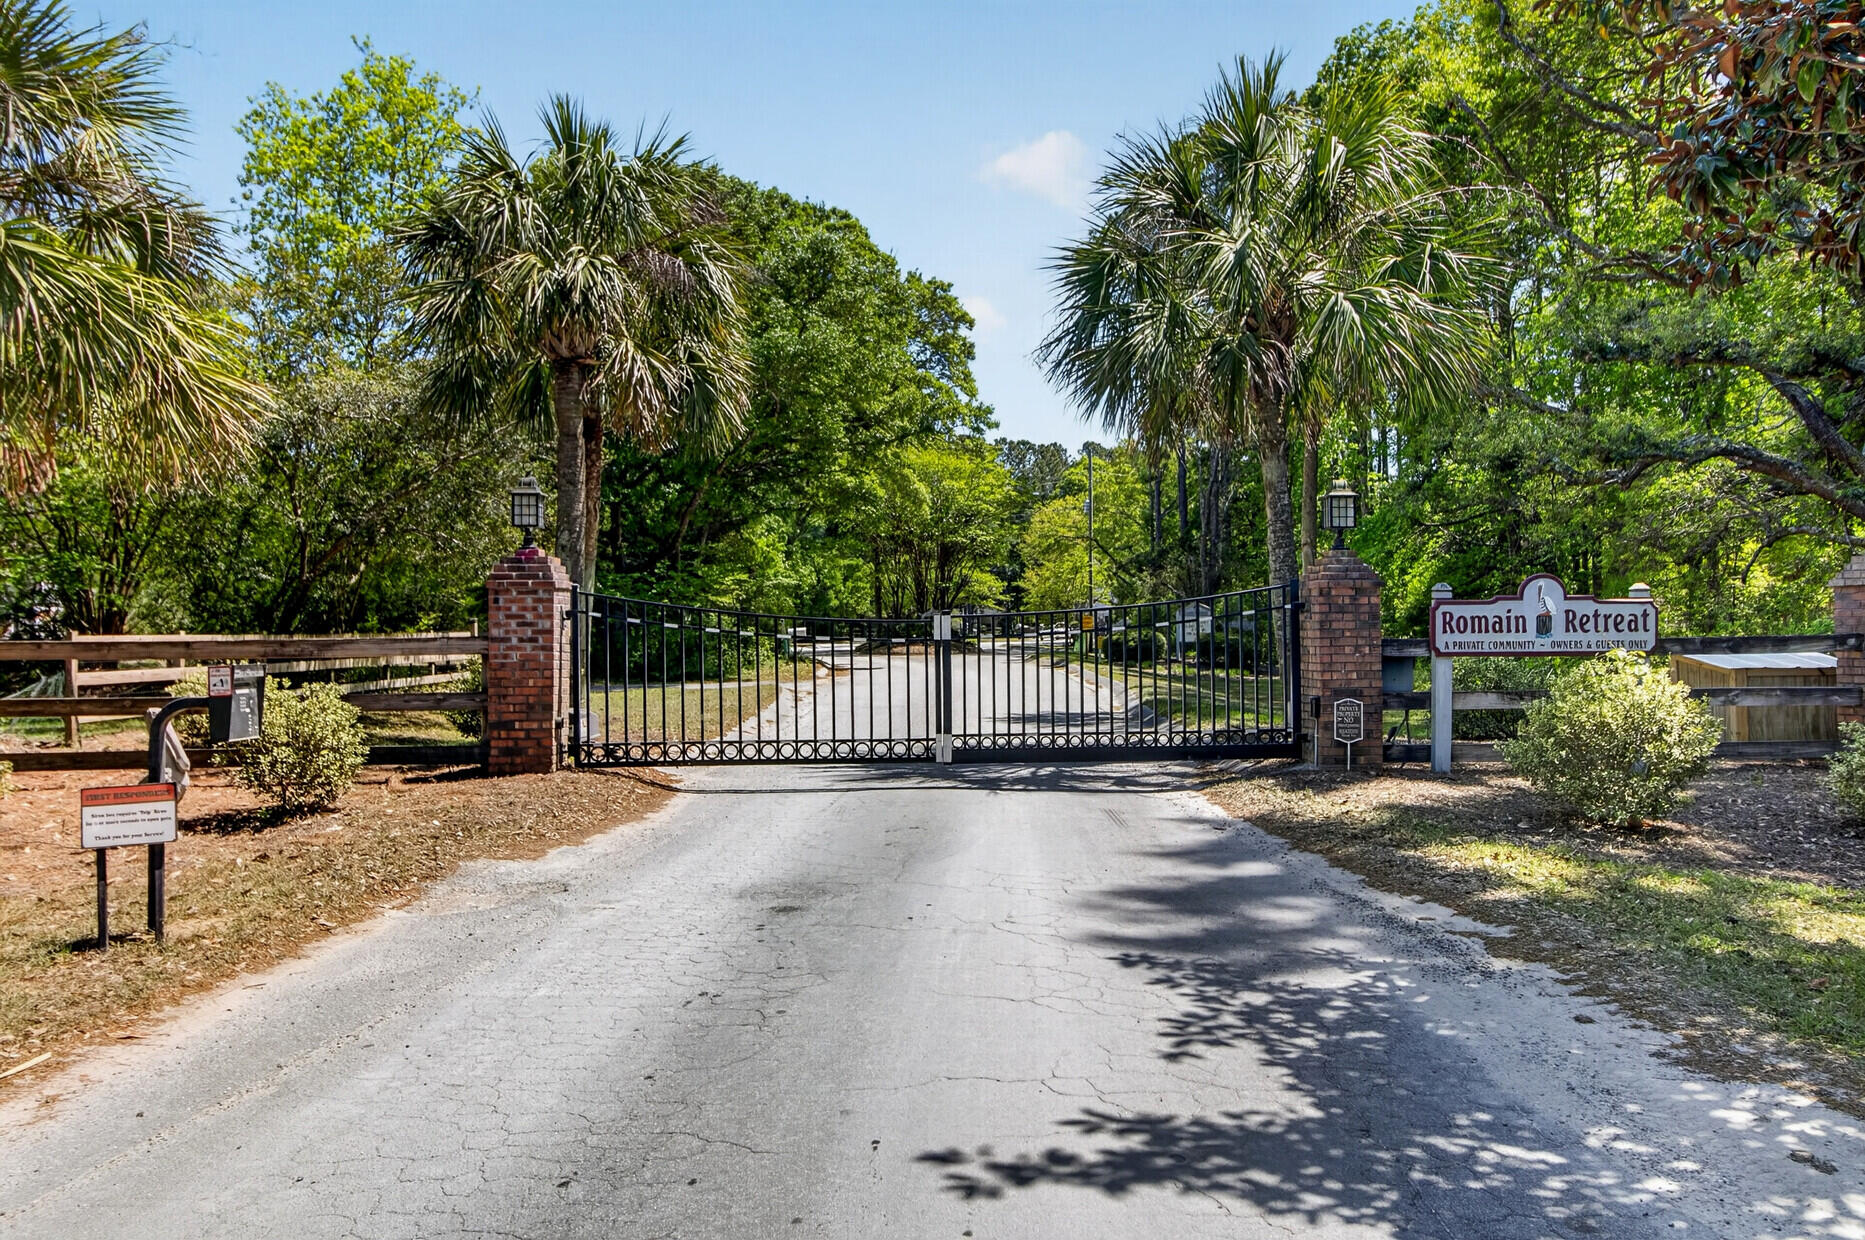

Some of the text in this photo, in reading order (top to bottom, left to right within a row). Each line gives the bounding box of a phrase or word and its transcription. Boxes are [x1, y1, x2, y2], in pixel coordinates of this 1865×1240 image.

[1441, 608, 1650, 634] Romain Retreat
[1444, 641, 1450, 650] A
[1452, 640, 1487, 650] PRIVATE
[1488, 640, 1536, 650] COMMUNITY
[1550, 640, 1583, 650] OWNERS
[1586, 640, 1592, 649] &
[1595, 640, 1625, 649] GUESTS
[1628, 640, 1648, 649] ONLY
